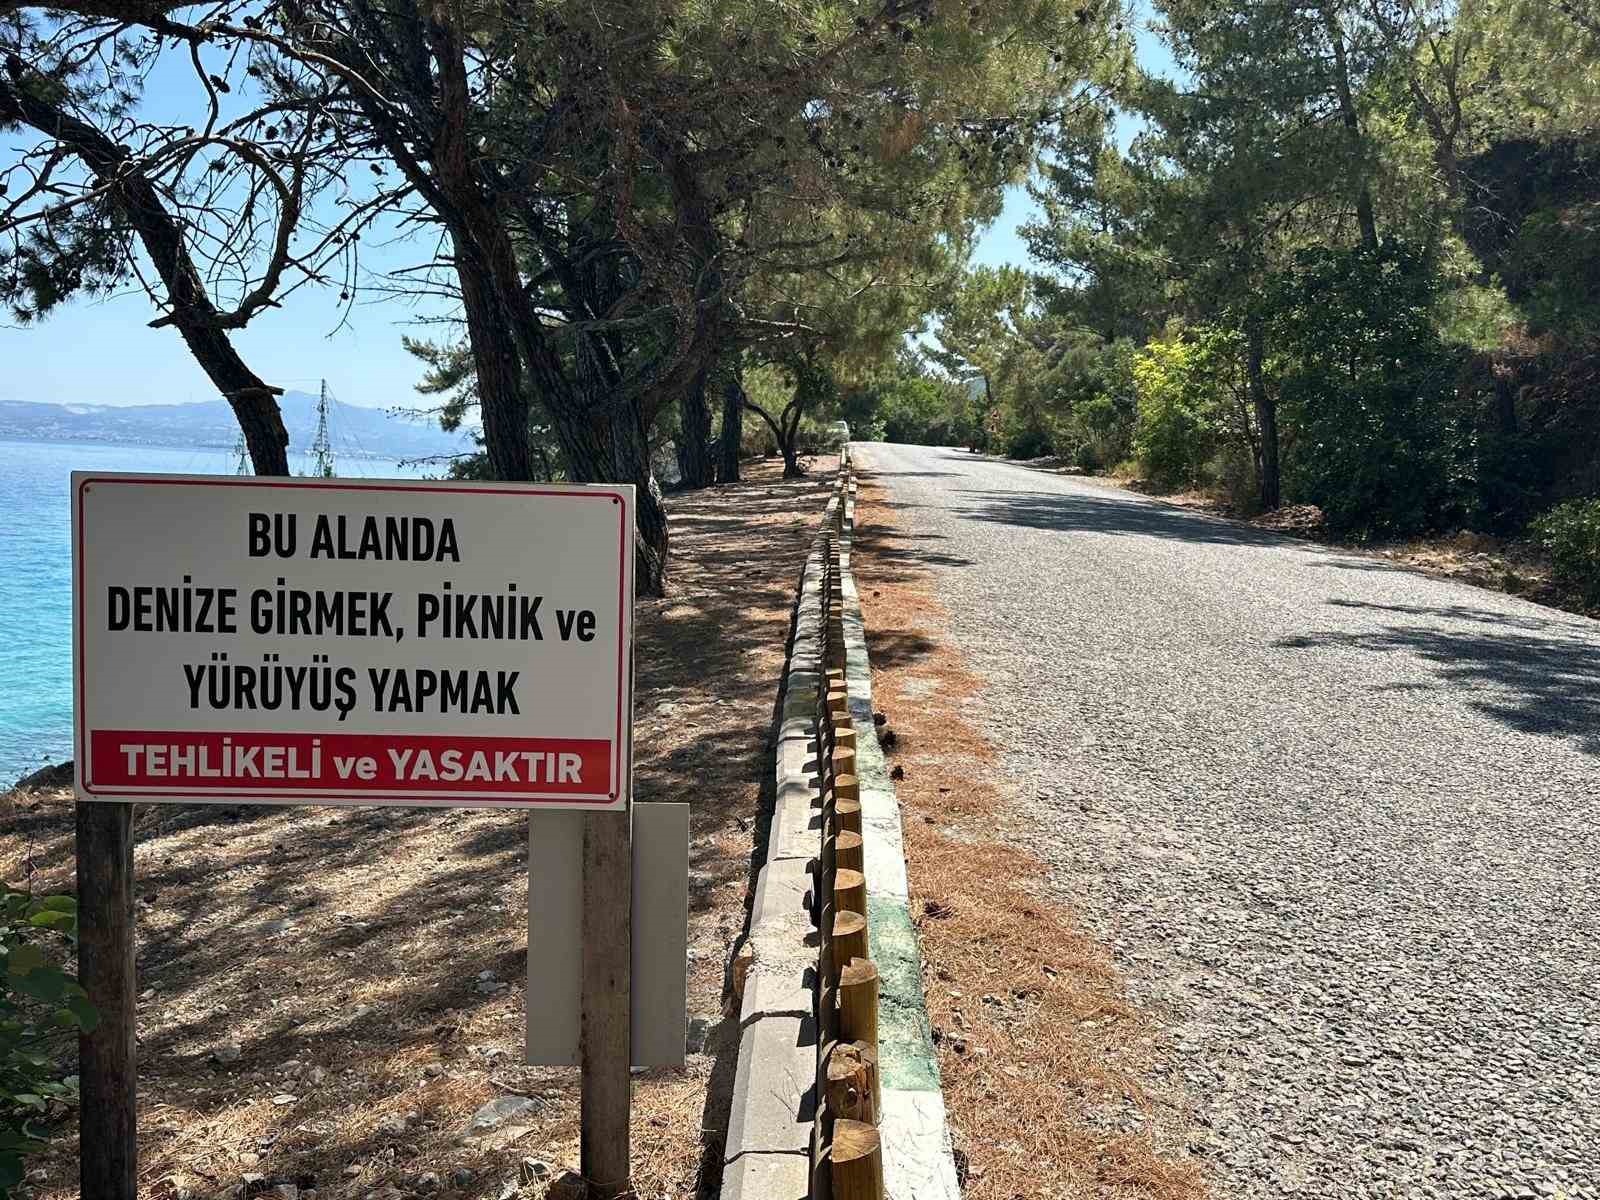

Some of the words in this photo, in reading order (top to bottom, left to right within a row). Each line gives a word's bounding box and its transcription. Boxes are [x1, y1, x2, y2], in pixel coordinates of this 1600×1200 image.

[248, 512, 297, 559] BU
[310, 514, 461, 563] ALANDA
[107, 575, 238, 634] DENİZE
[250, 576, 405, 644] GİRMEK,
[418, 581, 544, 641] PİKNİK
[556, 608, 597, 643] ve
[183, 652, 357, 721] YÜRÜYÜŞ
[368, 668, 520, 715] YAPMAK
[120, 737, 321, 779] TEHLİKELİ
[333, 755, 377, 781] ve
[388, 749, 582, 783] YASAKTIR
